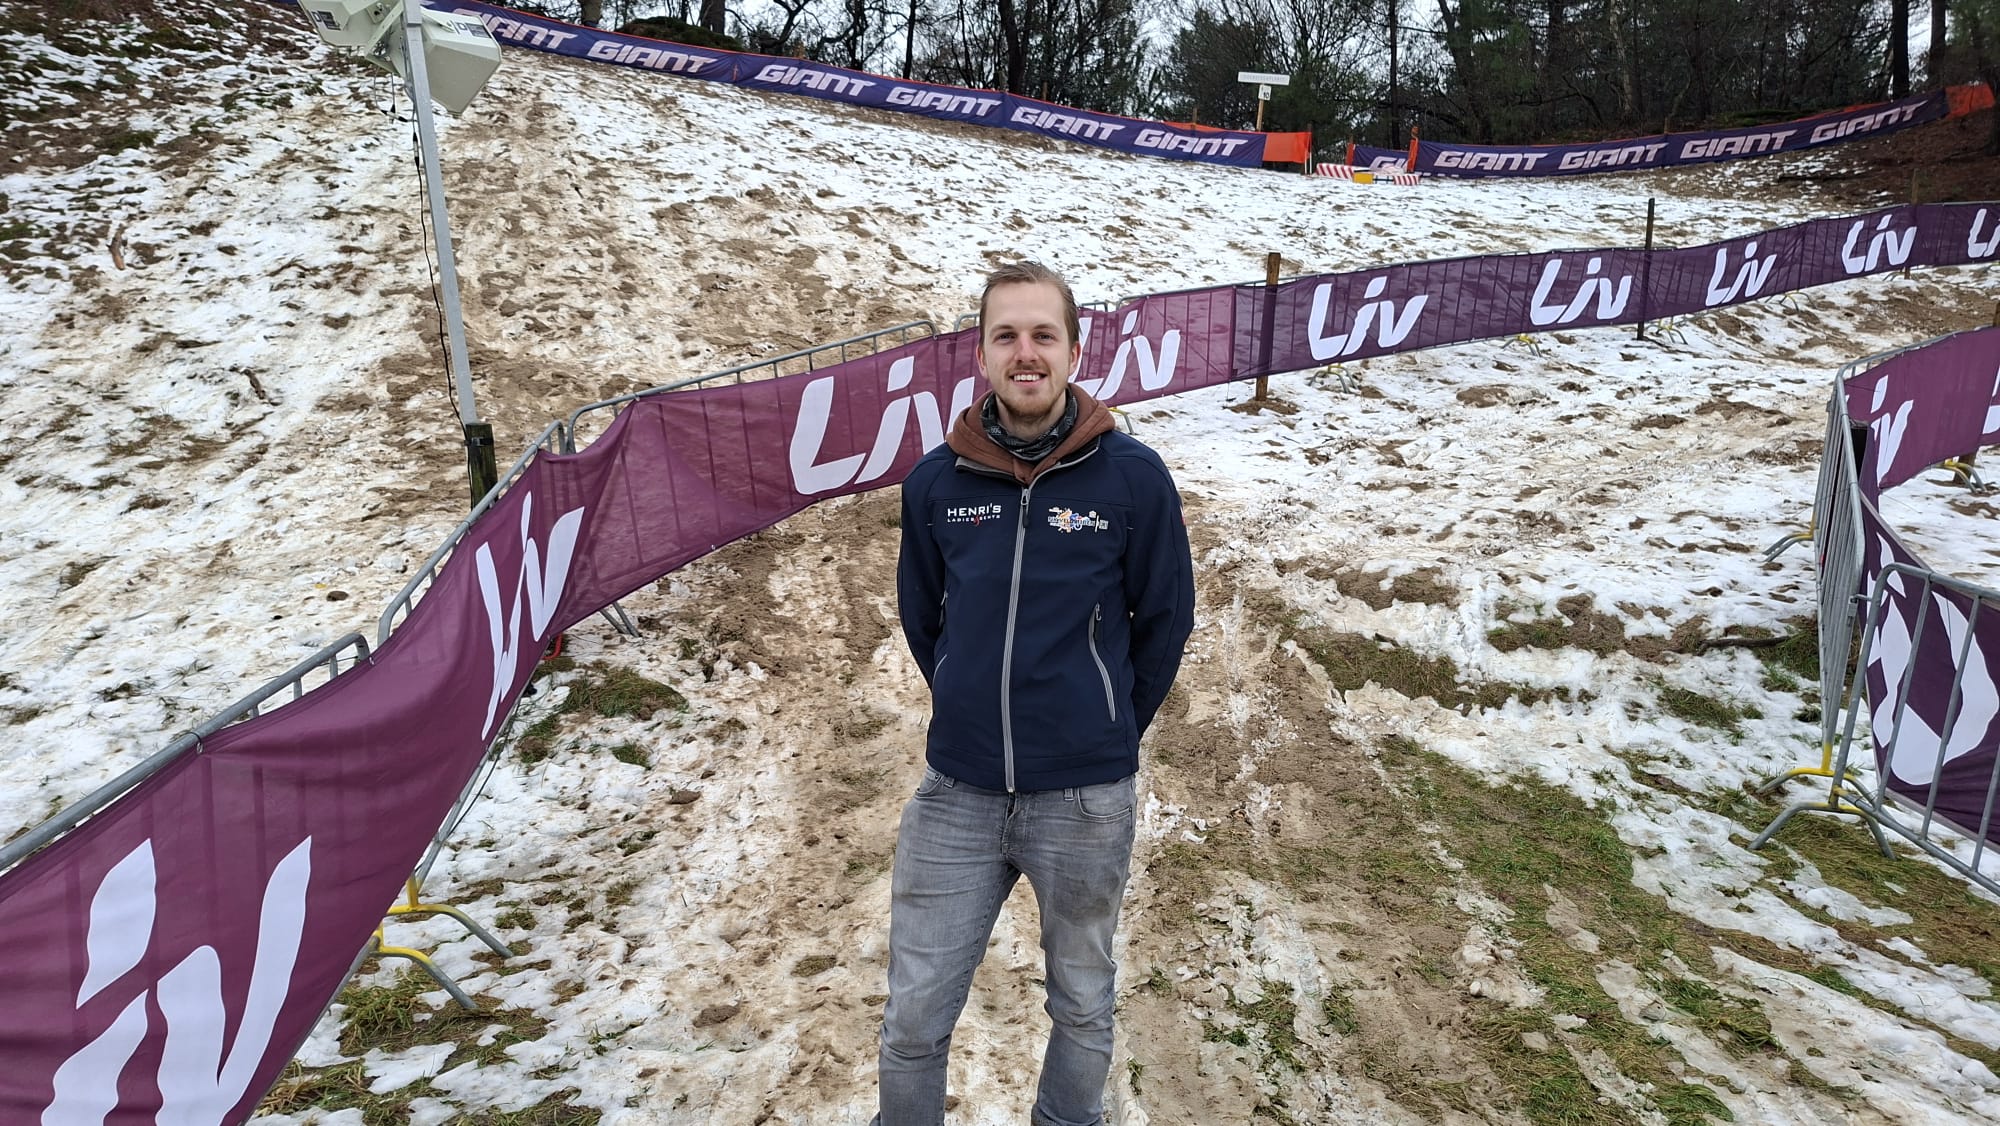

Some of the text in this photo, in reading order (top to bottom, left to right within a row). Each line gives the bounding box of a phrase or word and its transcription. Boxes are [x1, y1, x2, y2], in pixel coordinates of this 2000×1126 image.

[587, 40, 718, 73] GIANT
[754, 65, 877, 96] GIANT
[886, 86, 1002, 116] GIANT
[1010, 106, 1126, 141] GIANT
[1134, 129, 1248, 156] GIANT
[1434, 151, 1548, 171] GIANT
[1558, 142, 1669, 170] GIANT
[1680, 130, 1798, 159] GIANT
[1810, 100, 1928, 144] GIANT
[790, 355, 975, 495] Liv
[1307, 276, 1428, 360] Liv
[1530, 257, 1631, 325] Liv
[1705, 241, 1777, 307] Liv
[1842, 214, 1917, 274] Liv
[1968, 208, 2000, 258] Li
[947, 502, 1002, 517] HENRI'S
